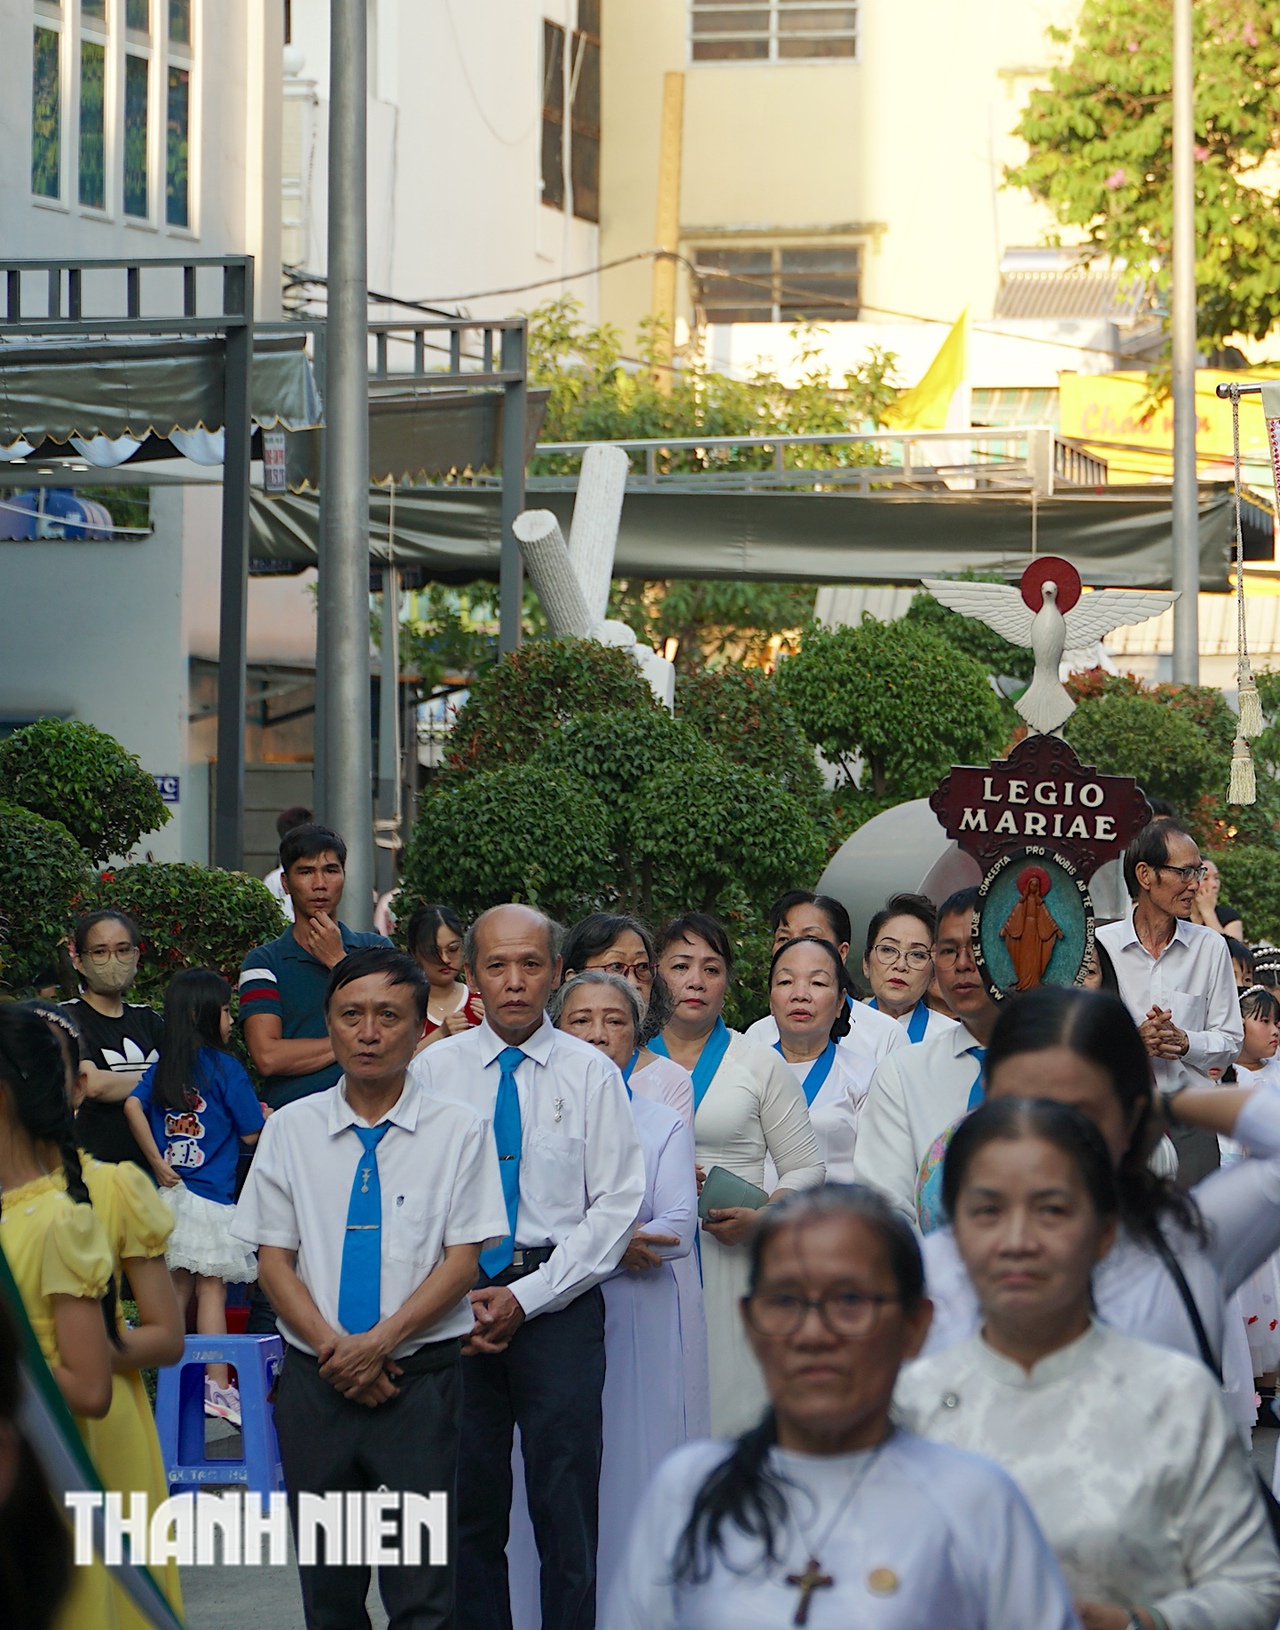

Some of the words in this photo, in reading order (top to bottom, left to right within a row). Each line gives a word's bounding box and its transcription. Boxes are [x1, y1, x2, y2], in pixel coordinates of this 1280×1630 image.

[982, 777, 1105, 808] LEGIO
[958, 807, 1119, 842] MARIAE
[970, 911, 981, 937] LABE
[1025, 845, 1045, 856] PRO
[1052, 852, 1078, 876] NOBIS
[1075, 880, 1088, 892] AD
[1082, 897, 1093, 909] TE
